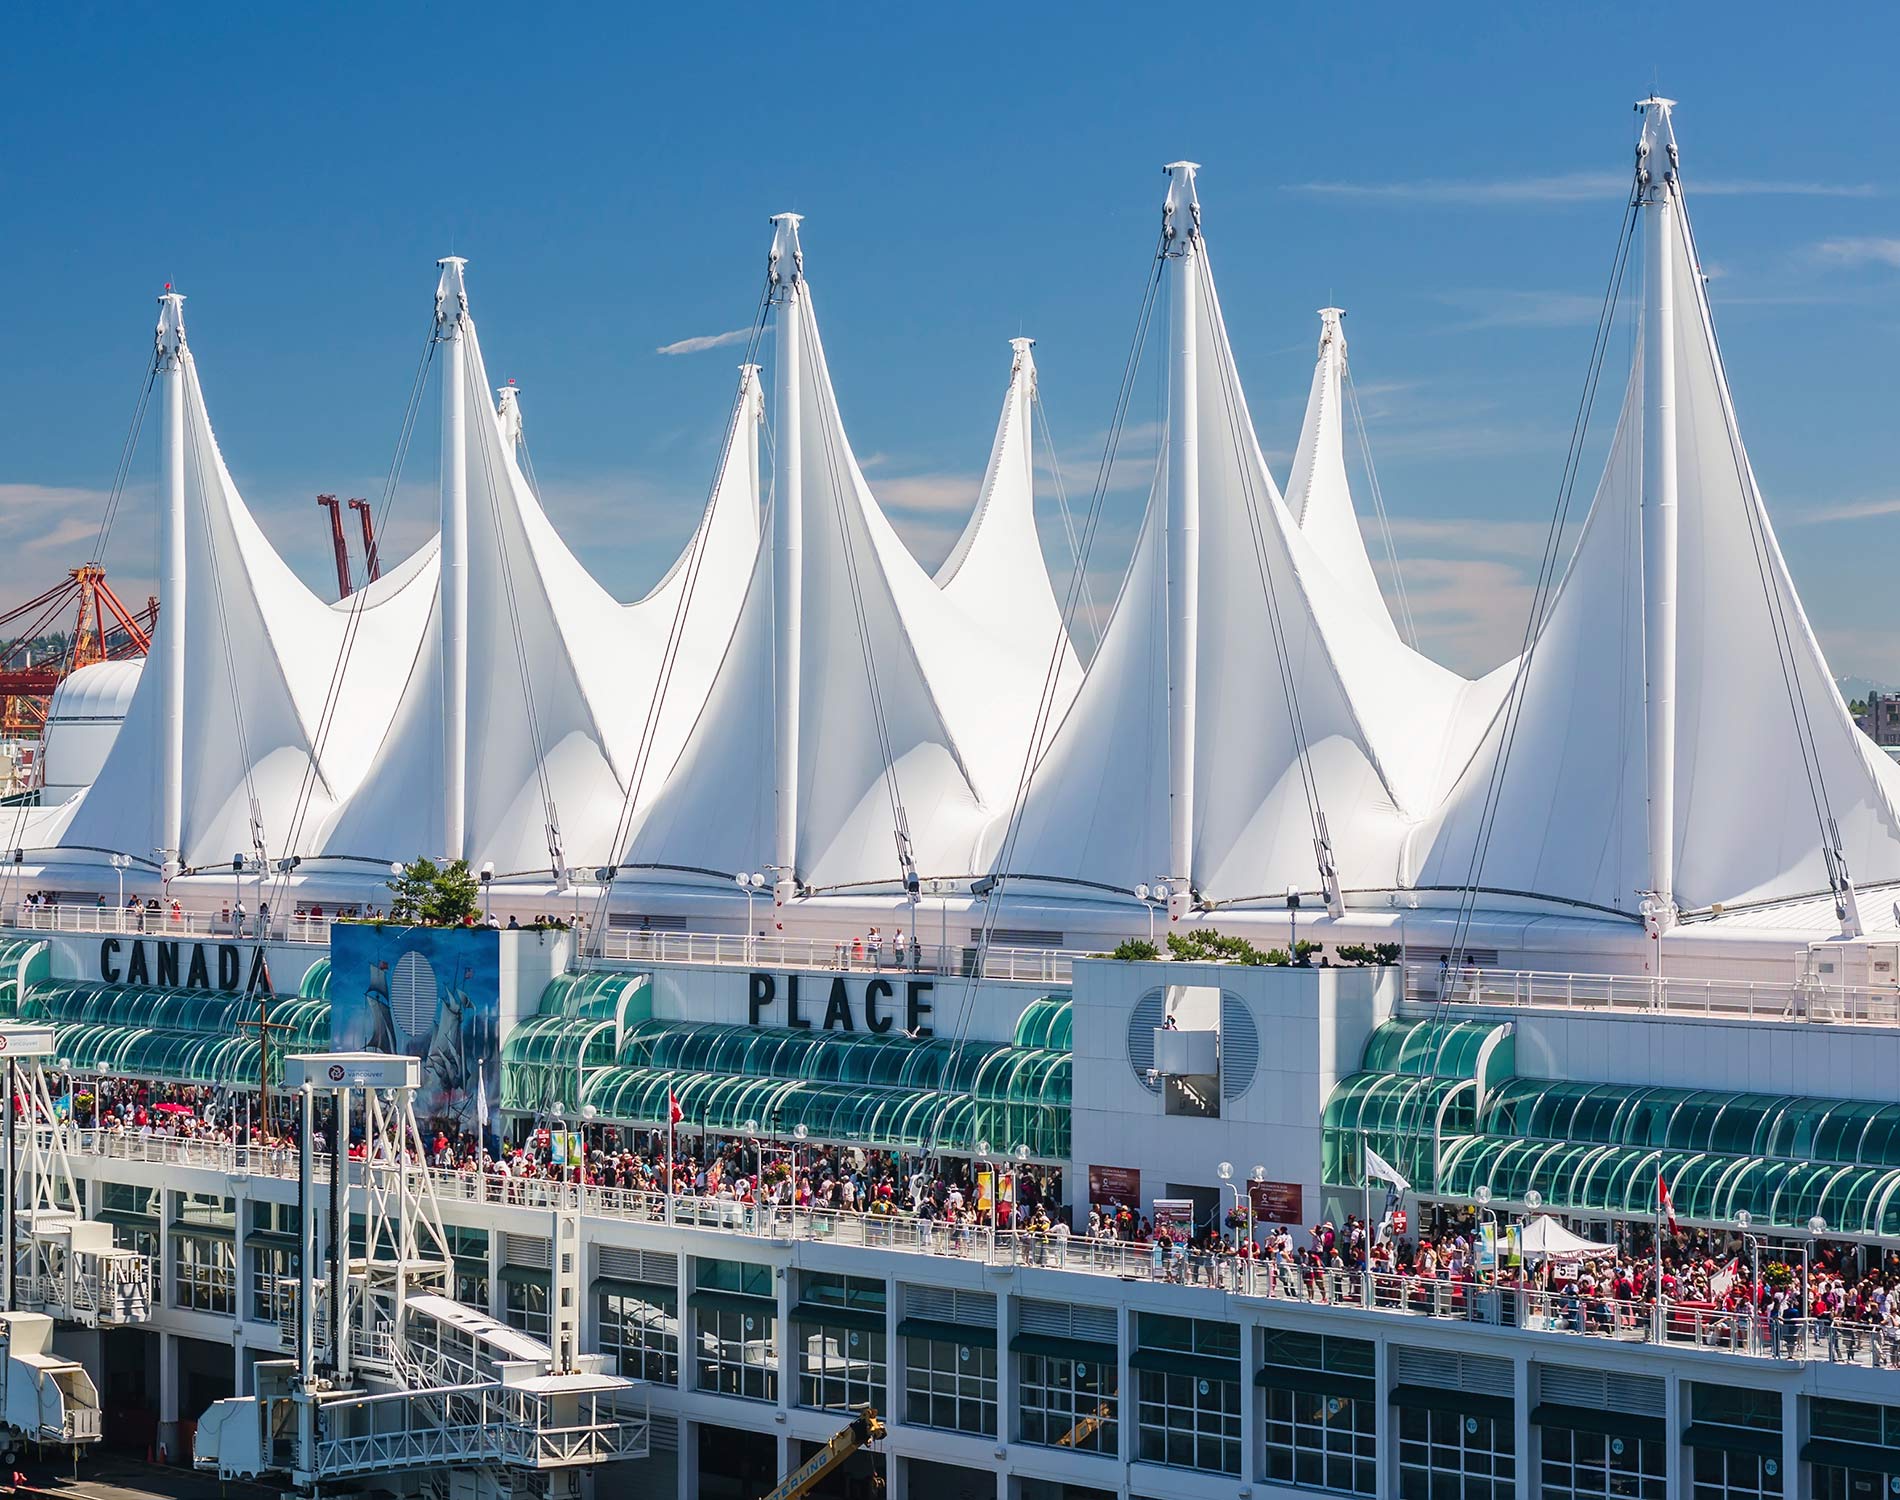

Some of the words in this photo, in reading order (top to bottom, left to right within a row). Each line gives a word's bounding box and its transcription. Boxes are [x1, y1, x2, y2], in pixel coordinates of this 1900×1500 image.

[101, 937, 271, 993] CANADA
[749, 972, 934, 1037] PLACE
[347, 1071, 384, 1079] vancouver
[769, 1453, 828, 1500] TERLING
